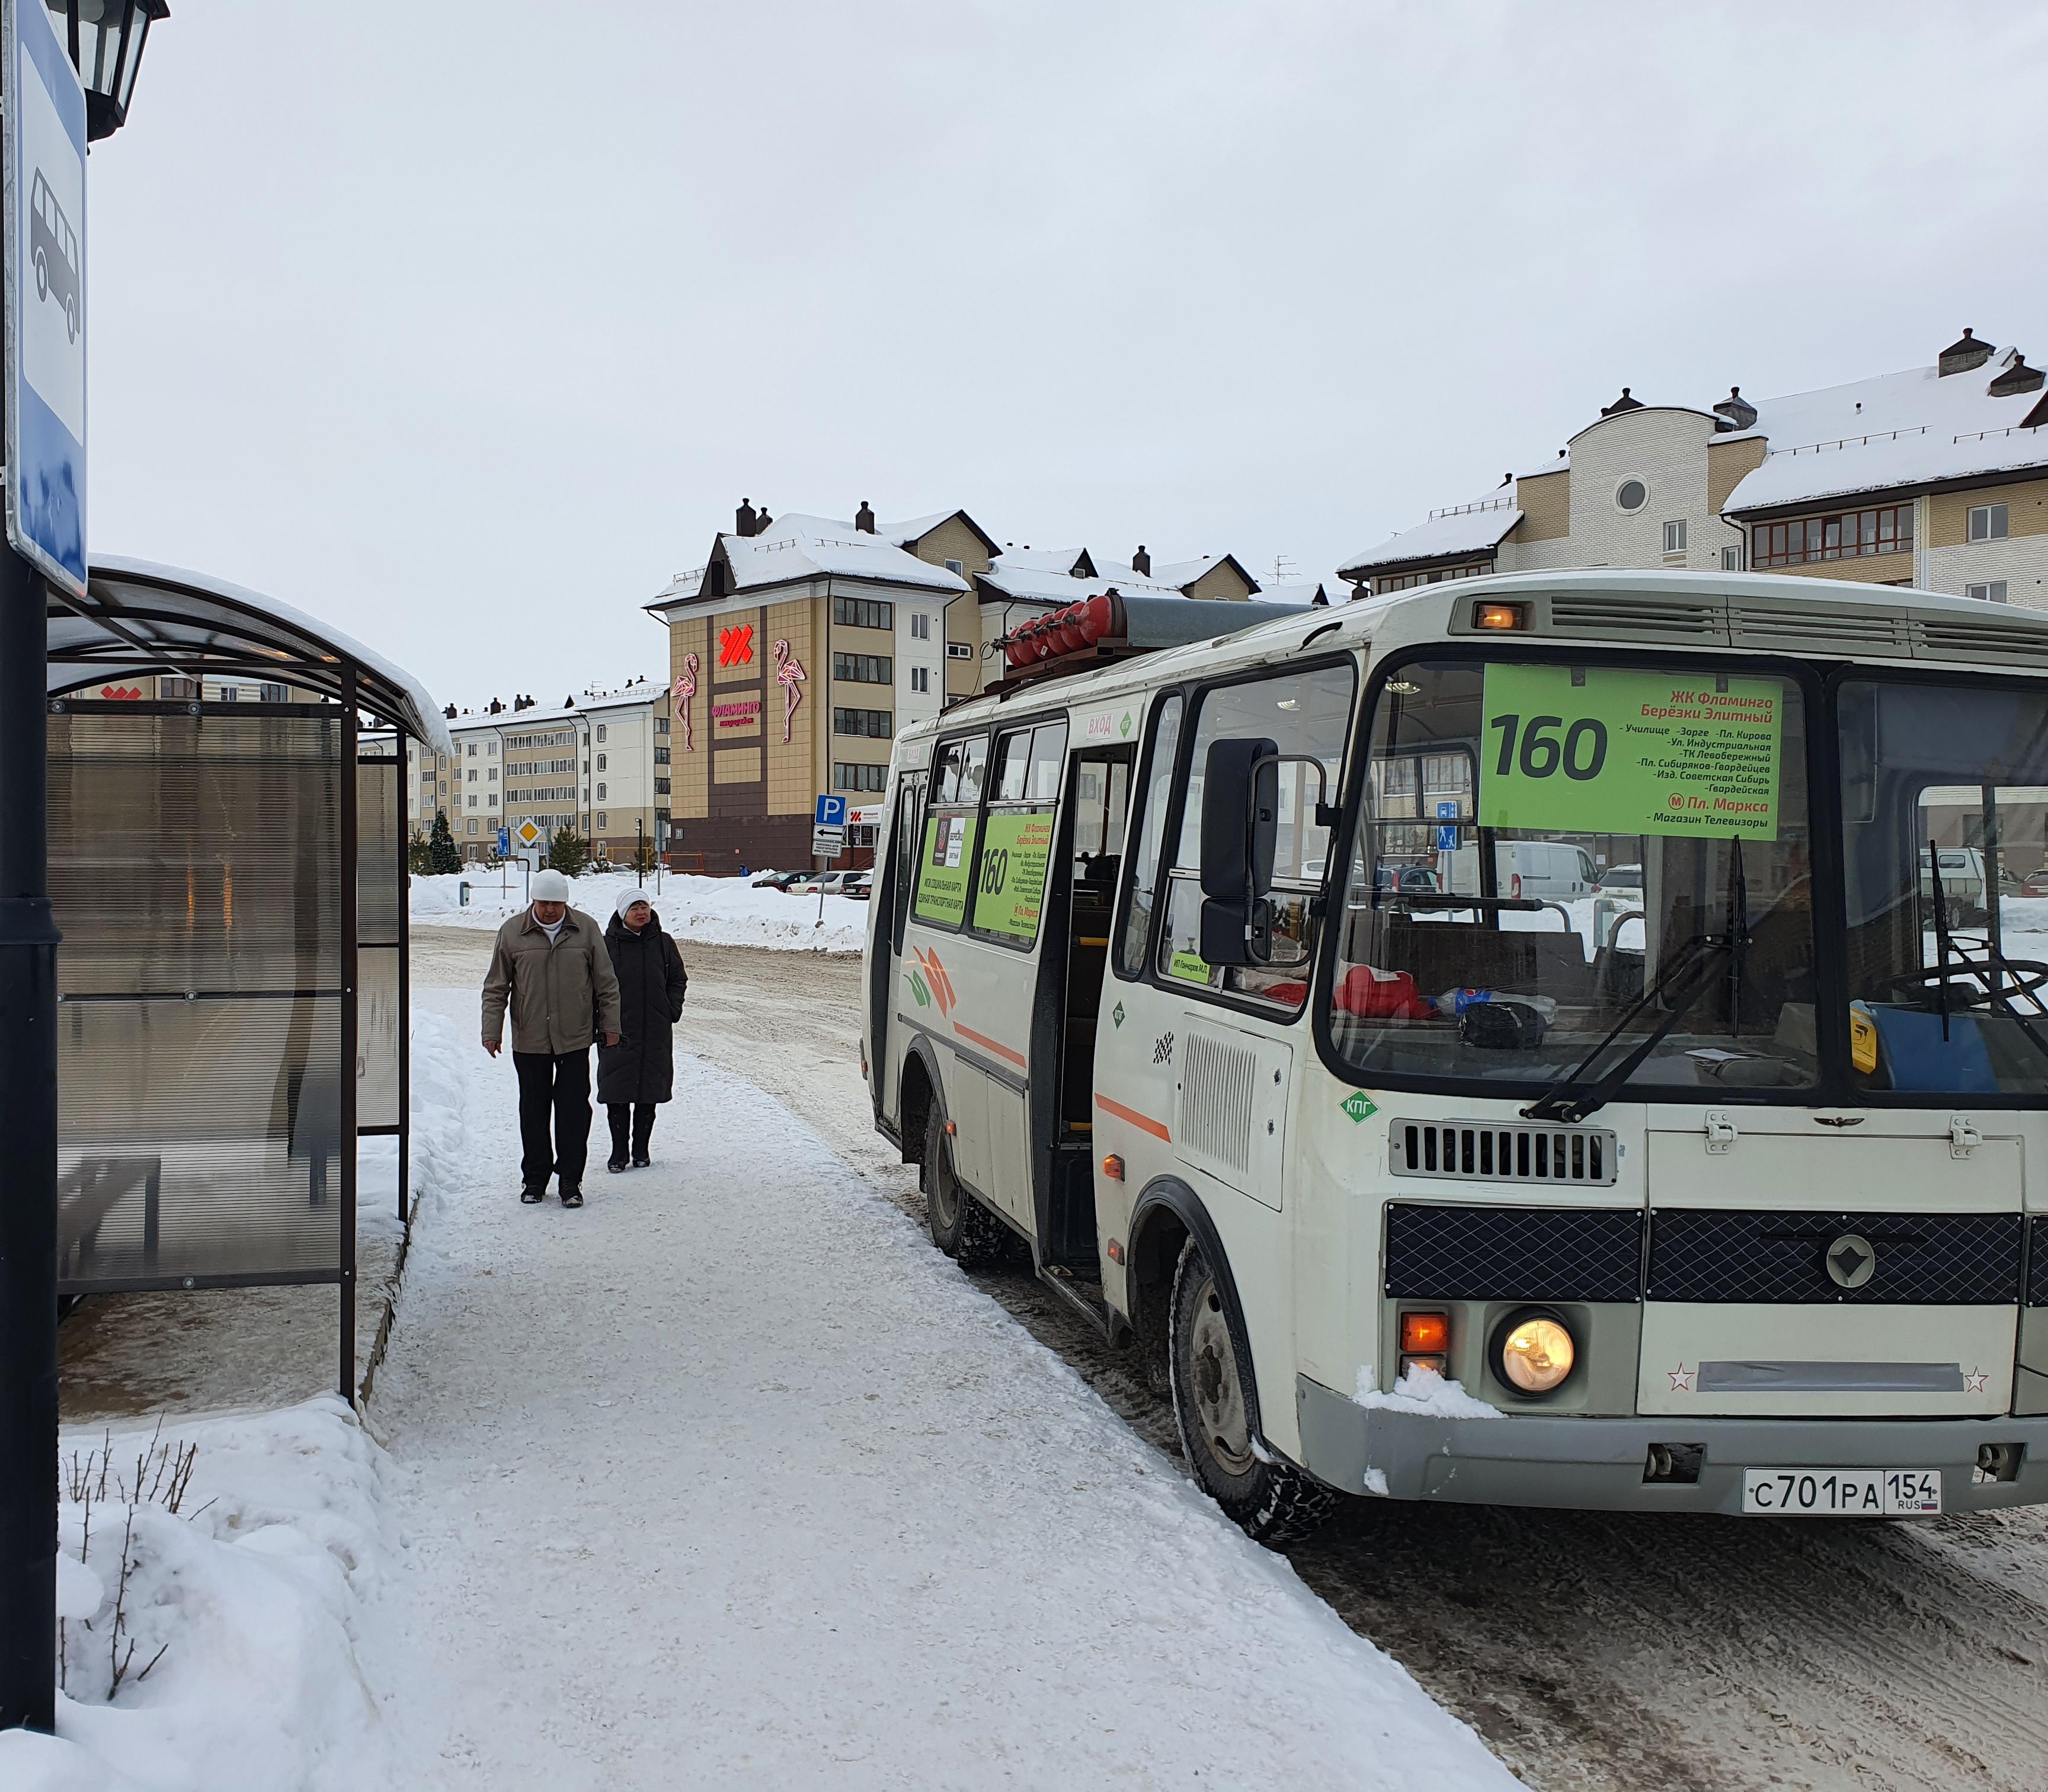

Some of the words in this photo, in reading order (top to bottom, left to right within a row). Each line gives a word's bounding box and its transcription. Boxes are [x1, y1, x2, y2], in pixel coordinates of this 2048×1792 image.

[1670, 690, 1695, 703] ЖК
[1698, 692, 1774, 709] Фламинго
[712, 701, 760, 717] ФЛАМИНГО
[1640, 703, 1701, 719] Берёзки
[1704, 707, 1773, 724] Элитный
[1088, 715, 1112, 735] ВХОД
[1625, 724, 1670, 735] Училище
[1736, 730, 1772, 741] Кирова
[1490, 713, 1608, 781] 160
[1687, 738, 1772, 751] Индустриальная
[1697, 750, 1771, 763] Левобережный
[1679, 771, 1733, 783] Советская
[1735, 774, 1770, 785] Сибирь
[1687, 796, 1710, 809] Пл.
[1713, 798, 1769, 814] Маркса
[1653, 812, 1701, 824] Магазин
[1704, 815, 1768, 828] Телевизоры
[980, 848, 1008, 895] 160
[1173, 959, 1180, 967] ИП
[1346, 1099, 1371, 1115] КПГ
[1755, 1475, 1880, 1509] С701РА
[1887, 1474, 1932, 1500] 154
[1897, 1500, 1921, 1510] RUS
